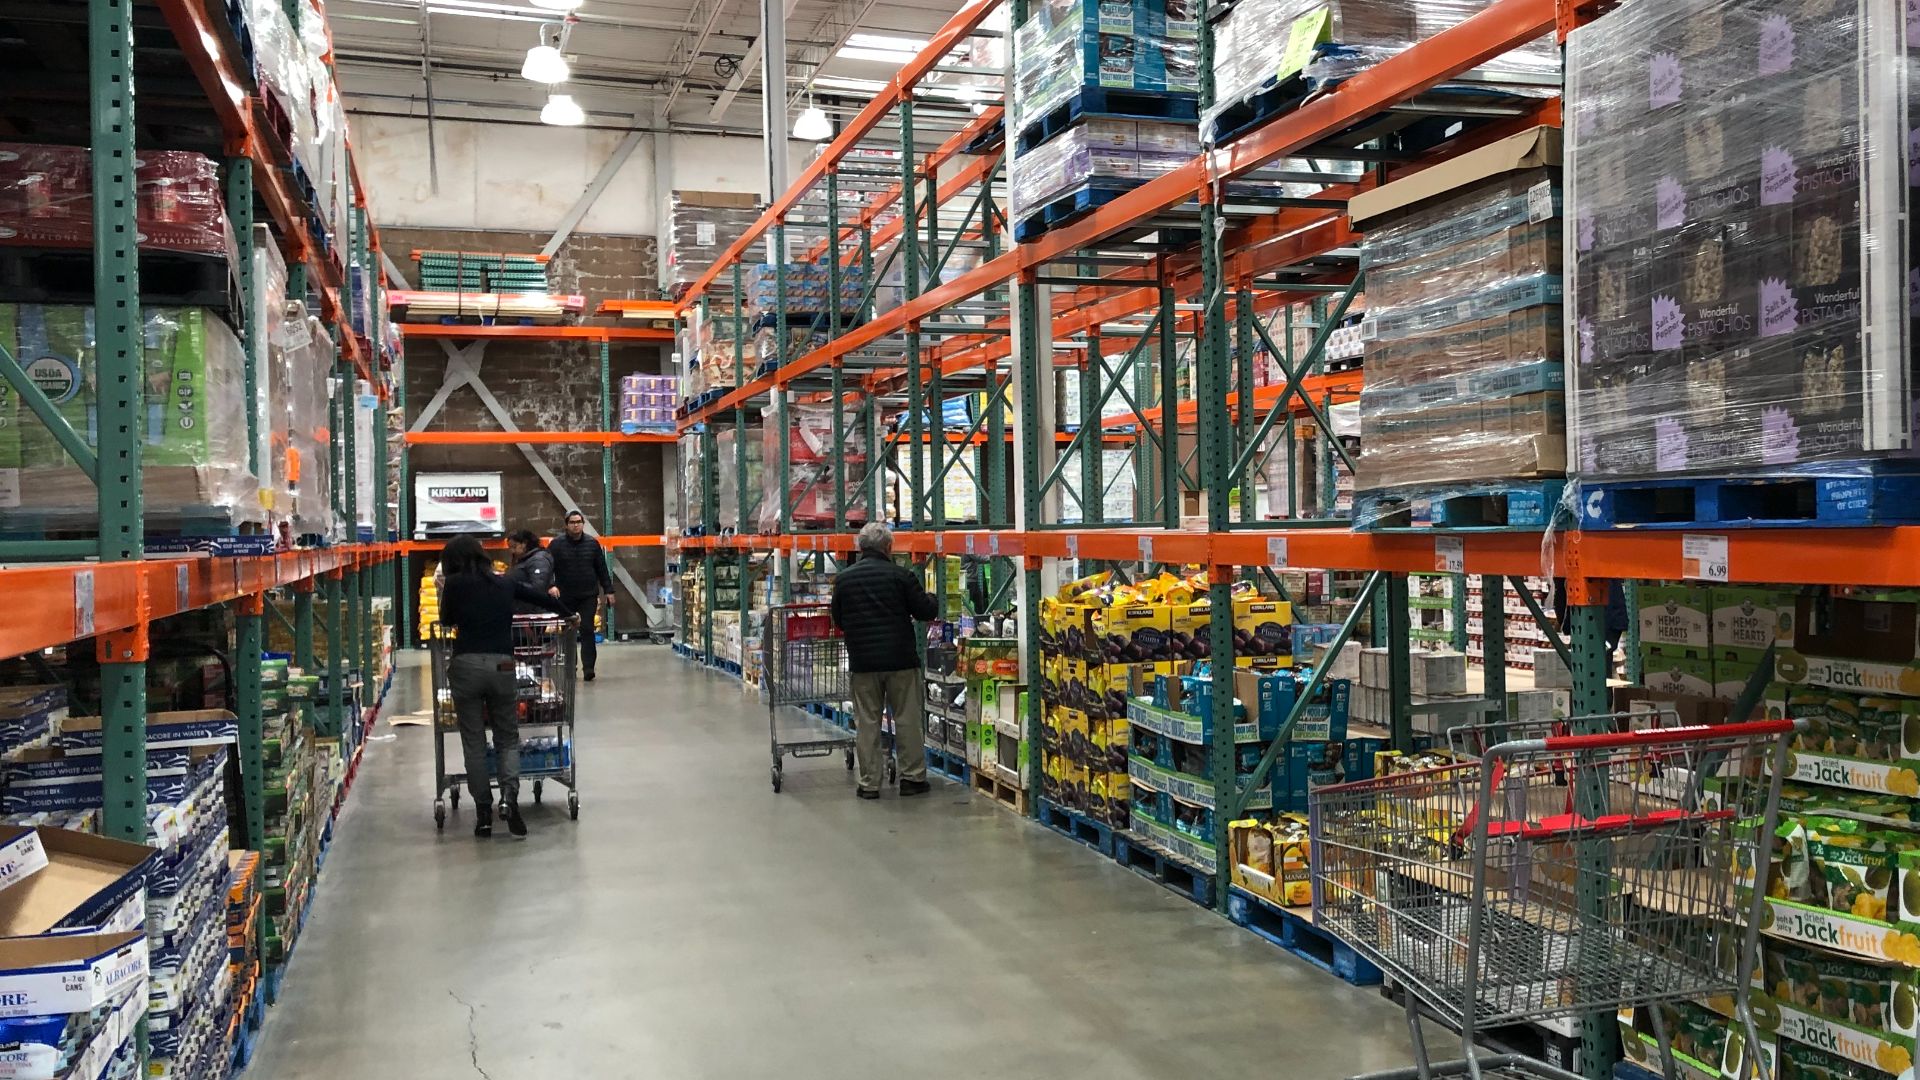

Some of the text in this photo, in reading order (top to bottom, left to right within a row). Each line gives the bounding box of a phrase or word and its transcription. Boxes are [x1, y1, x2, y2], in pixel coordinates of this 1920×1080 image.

[1764, 173, 1792, 193] Pepper
[1689, 186, 1750, 216] PISTACHIOS
[1815, 287, 1860, 304] Wonderful
[1699, 303, 1739, 319] Wonderful
[1765, 295, 1787, 316] Salt &
[1656, 310, 1676, 331] Salt &
[1765, 306, 1792, 328] Pepper
[1656, 321, 1680, 341] Pepper
[1688, 315, 1751, 338] PISTACHIOS
[1597, 333, 1649, 353] PISTACHIOS
[35, 369, 62, 378] USDA
[431, 488, 487, 498] KIRKLAND
[1708, 565, 1727, 577] 6.99
[1658, 615, 1681, 626] HEMP
[1733, 616, 1759, 628] HEMP
[1658, 626, 1688, 639] HEARTS
[1733, 629, 1766, 642] HEARTS
[1825, 665, 1898, 689] Jackfruit
[1662, 682, 1685, 693] HEMP
[183, 729, 205, 737] WATER
[58, 767, 80, 775] WHITE
[1814, 762, 1883, 790] Jackfruit
[31, 799, 53, 807] SOLID
[54, 797, 77, 805] WHITE
[1838, 851, 1887, 866] Jackfruit
[1803, 911, 1826, 925] dried
[1795, 914, 1878, 953] Jackfruit
[106, 959, 142, 986] ALBACORE
[65, 983, 83, 991] CANS
[1799, 1018, 1873, 1063] Jackfruit
